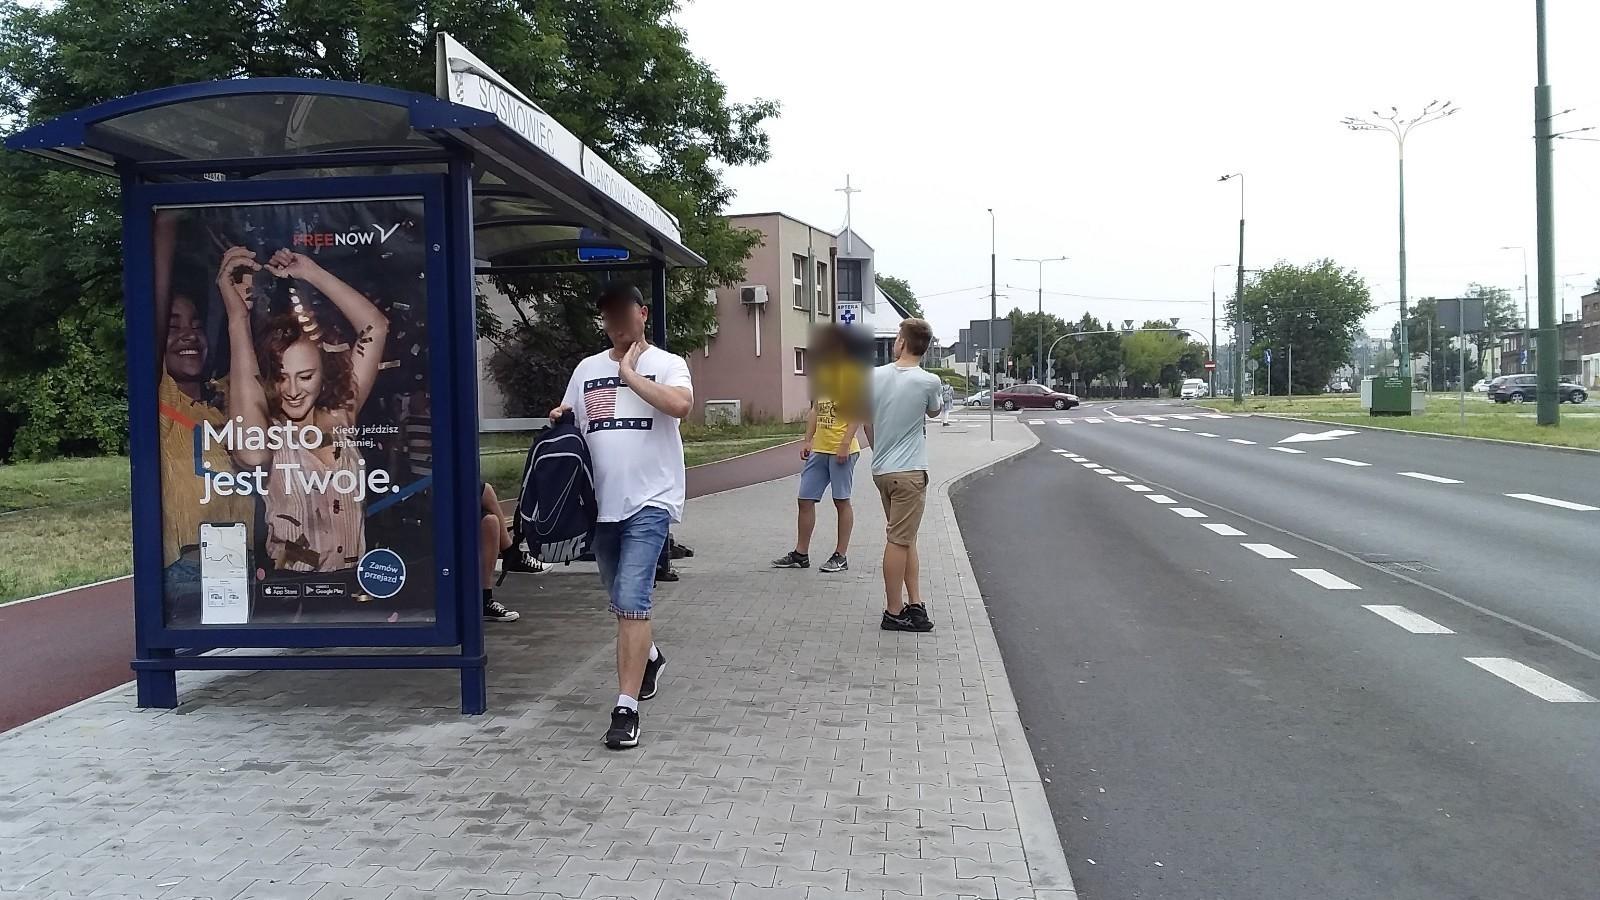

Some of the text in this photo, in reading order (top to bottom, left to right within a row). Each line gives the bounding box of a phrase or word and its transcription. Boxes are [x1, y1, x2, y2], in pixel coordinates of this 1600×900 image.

[479, 75, 555, 156] SOSNOWIEC
[203, 416, 323, 451] Miasto
[332, 424, 399, 436] Kiedy jeździsz
[332, 437, 377, 450] najtaniej.
[200, 458, 400, 504] jest Twoje.
[538, 531, 587, 563] NIKE
[364, 571, 397, 583] przejazd
[369, 561, 398, 574] Zamów
